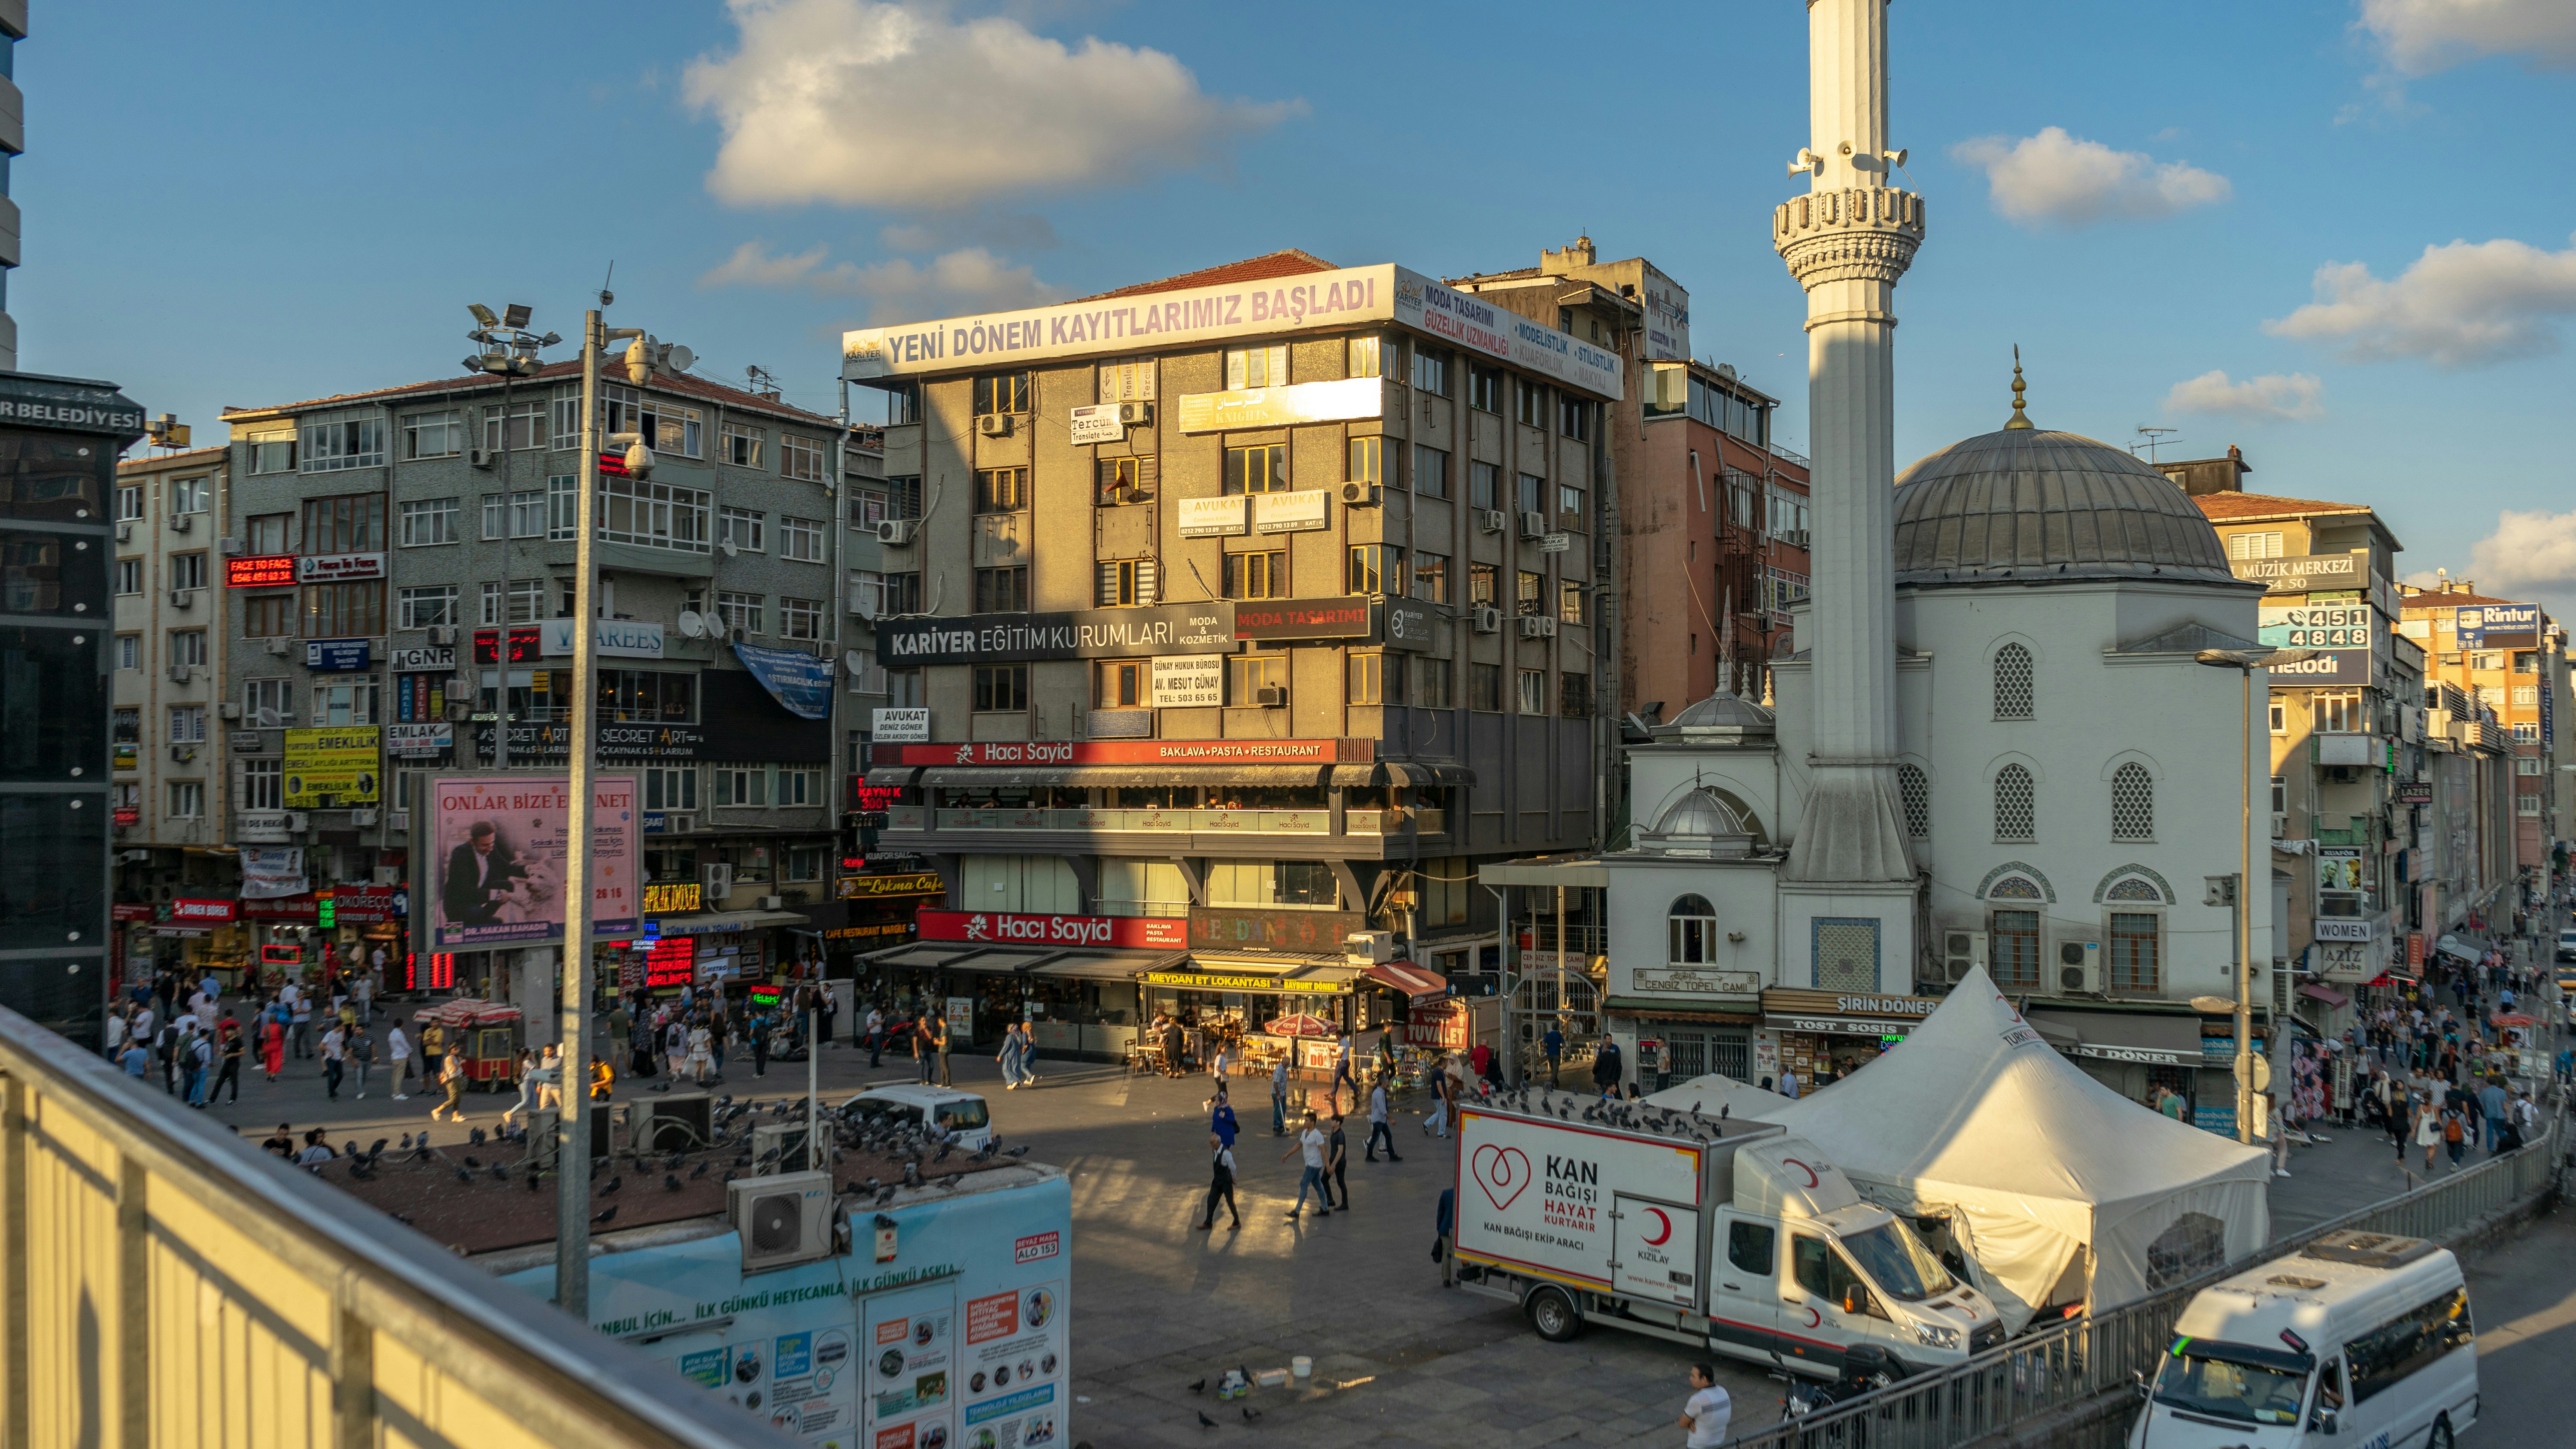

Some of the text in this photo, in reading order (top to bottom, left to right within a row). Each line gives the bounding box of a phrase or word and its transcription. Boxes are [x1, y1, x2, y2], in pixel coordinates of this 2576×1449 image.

[1395, 290, 1422, 308] KARİYER
[1425, 285, 1494, 328] MODA TASARIMI
[1649, 288, 1686, 331] MAX
[1660, 302, 1675, 316] BURGER
[889, 278, 1374, 364] YENİ DÖNEM KAYITLARIMIZ BAŞLADI
[1425, 309, 1509, 357] GÜZELLİK UZMANLIĞI
[846, 350, 881, 360] KARİYER
[1519, 323, 1614, 374] MODELİSTLİK STİLİSTLİK
[1519, 343, 1606, 390] KUAFÖRLÜK MAKYAJ
[1217, 393, 1265, 411] الفرسان
[18, 403, 141, 429] BELEDİYESİ
[1215, 409, 1269, 424] KNIGHTS
[1072, 431, 1100, 441] Translate
[1194, 499, 1244, 512] AVUKAT
[1271, 493, 1323, 507] AVUKAT
[231, 559, 293, 571] FACE TO FACE
[318, 560, 340, 570] Face
[354, 557, 377, 567] Face
[2242, 556, 2354, 578] MÜZİK MERKEZİ
[2288, 578, 2307, 589] 50
[1189, 617, 1218, 626] MODA
[1237, 609, 1366, 627] MODA TASARIMI
[1405, 610, 1423, 620] KARİYER
[2484, 607, 2536, 622] Rintur
[892, 621, 1173, 655] KARİYER EĞİTİM KURUMLARI
[1179, 632, 1228, 645] KOZMETİK
[1200, 626, 1207, 634] &
[407, 649, 454, 666] GNR
[1154, 658, 1219, 670] GÜNAY HUKUK BÜROSU
[1155, 673, 1219, 690] AV. MESUT GÜNAY
[402, 676, 410, 719] KİRALIK
[417, 676, 425, 719] SATILIK
[1159, 694, 1176, 703] TEL:
[1178, 694, 1192, 702] 503
[884, 706, 927, 721] AVUKAT
[389, 725, 438, 739] EMLAK
[488, 725, 569, 744] SCRET ART
[880, 722, 923, 731] DENİZ GÖNER
[318, 736, 378, 750] EMEKLİLİK
[601, 728, 688, 746] SECRET ART
[985, 743, 1073, 764] Hacı Sayid
[1160, 746, 1321, 757] BAKLAVA PASTA RESTAURANT
[2401, 788, 2430, 796] LAZER
[443, 792, 630, 810] ONLAR BİZE ENET
[861, 798, 884, 809] 300
[596, 887, 622, 899] 26 15
[869, 877, 945, 894] Lokma Cafe
[185, 903, 229, 916] ÖRNEK BÖREK
[666, 925, 708, 935] TÜRK HAVA
[826, 923, 907, 940] CAFE RESTAURANT NARGİLE
[997, 915, 1112, 944] Hacı Sayid
[1194, 919, 1276, 942] MEYDAN
[2320, 925, 2366, 937] WOMEN
[2327, 948, 2362, 963] AZİZ
[1148, 973, 1270, 988] MEYDAN ET LOKANTASI
[1284, 980, 1338, 991] BAYBURT DÖNERİ
[1685, 981, 1717, 991] TOPEL
[1837, 995, 1936, 1014] ŞİRİN DÖNER
[1408, 1024, 1464, 1045] TUVALET
[1793, 1021, 1897, 1034] TOST SOSİS
[2106, 1049, 2179, 1063] DÖNER
[1546, 1154, 1598, 1185] KAN
[1546, 1180, 1597, 1204] BAĞIŞI
[1544, 1199, 1597, 1220] HAYAT
[1544, 1214, 1595, 1233] KURTARIR
[1017, 1233, 1058, 1248] BEYAZ MASA
[1484, 1221, 1584, 1251] KAN BAĞIŞI EKİP ARACI
[1018, 1243, 1057, 1260] ALO 153
[1637, 1250, 1670, 1265] KIZILAY
[852, 1267, 917, 1293] İLK GÜNKÜ
[1627, 1273, 1677, 1291] www.kanver.org
[695, 1282, 847, 1319] İLK GÜNKÜ HEYECANLA,
[601, 1316, 640, 1336] NBUL
